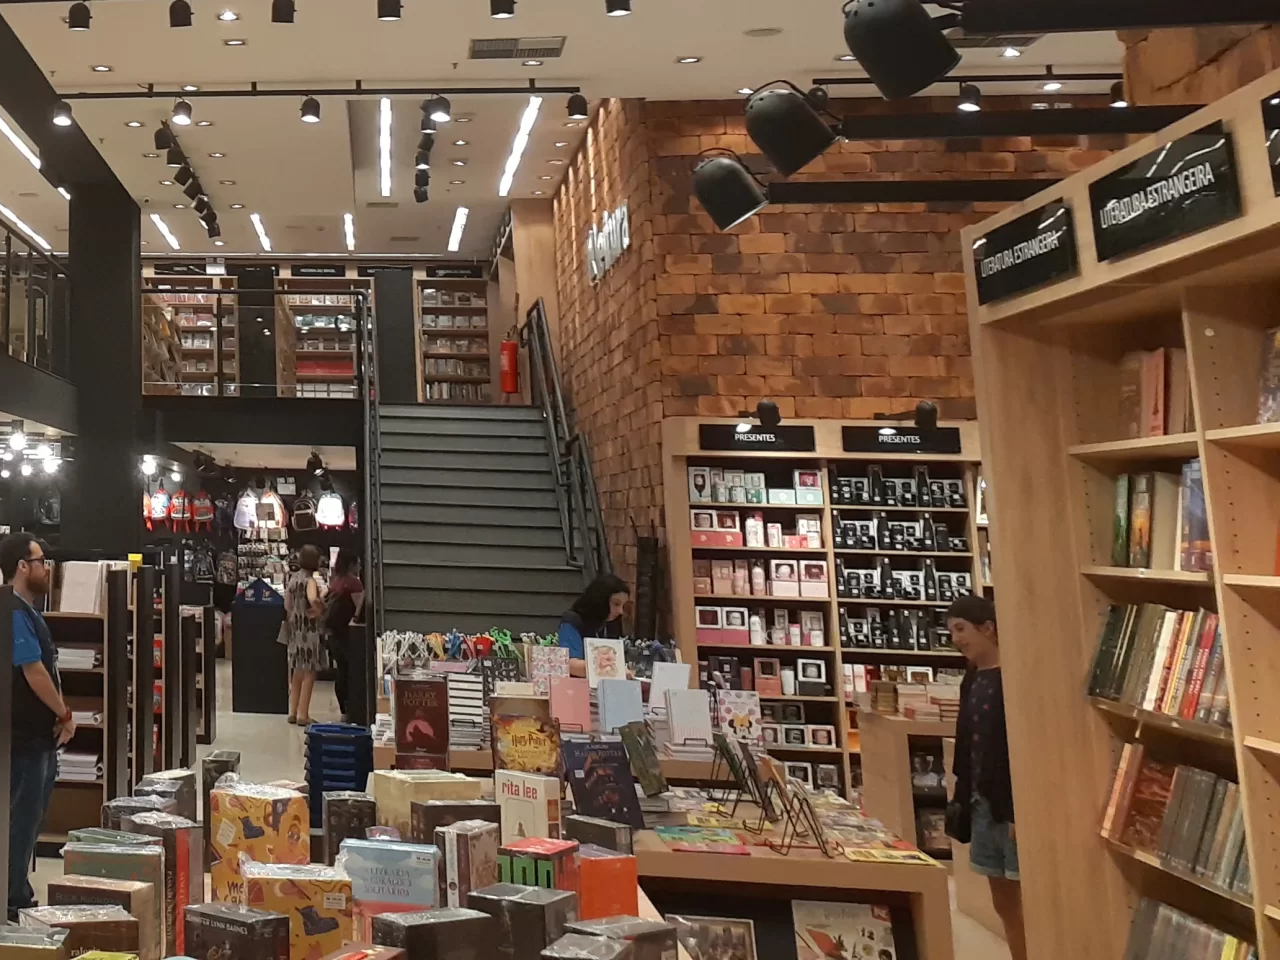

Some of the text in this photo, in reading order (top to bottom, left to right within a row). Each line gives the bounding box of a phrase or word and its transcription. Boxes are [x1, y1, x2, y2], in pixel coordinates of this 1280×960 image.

[1100, 162, 1215, 228] LITERATURA ESTRANGEIRA
[981, 230, 1060, 277] LITERATURA ESTRANGEIRA
[734, 433, 775, 442] PRESENTES
[878, 435, 920, 444] PRESENTES
[403, 698, 439, 707] POTTER
[502, 779, 538, 800] rita lee
[210, 919, 226, 929] LYNN
[226, 923, 248, 935] BARNES
